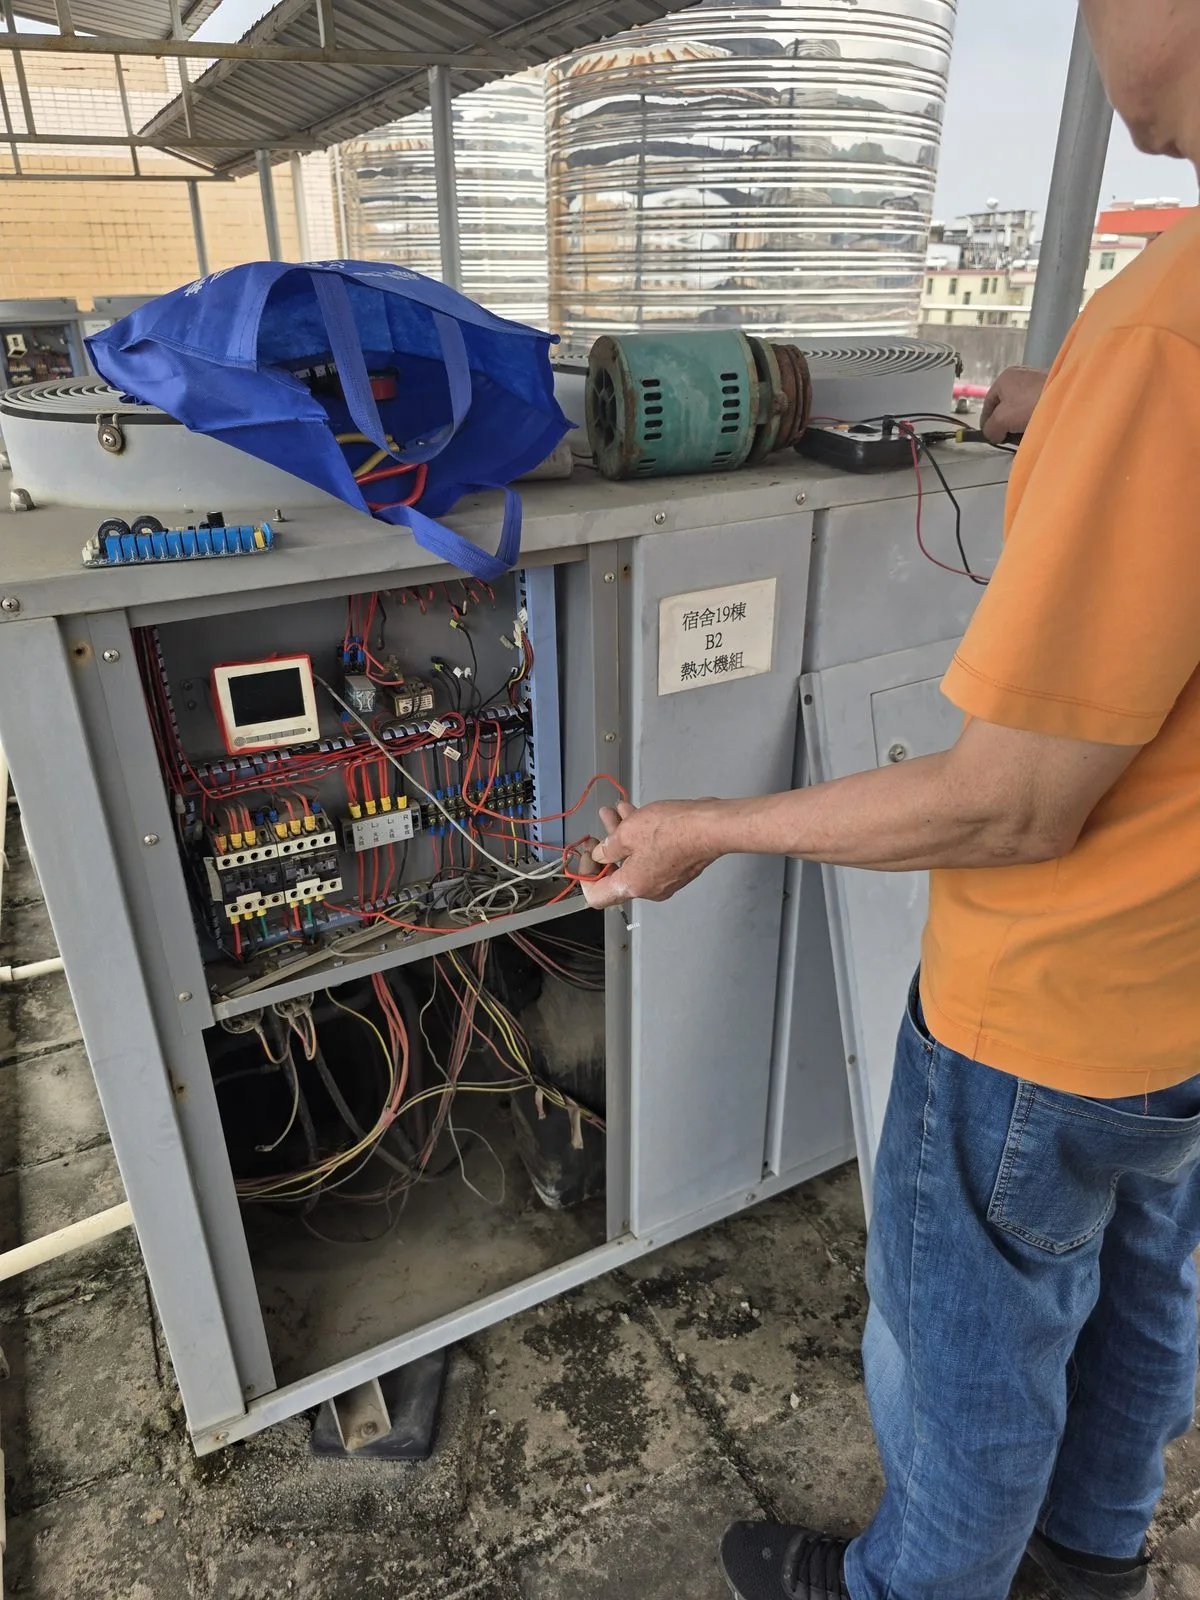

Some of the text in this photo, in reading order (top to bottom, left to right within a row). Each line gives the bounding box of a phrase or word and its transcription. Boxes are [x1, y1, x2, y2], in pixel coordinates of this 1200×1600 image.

[682, 602, 747, 631] 宿舍19棟
[705, 632, 723, 650] B2
[680, 652, 744, 681] 熱水機組
